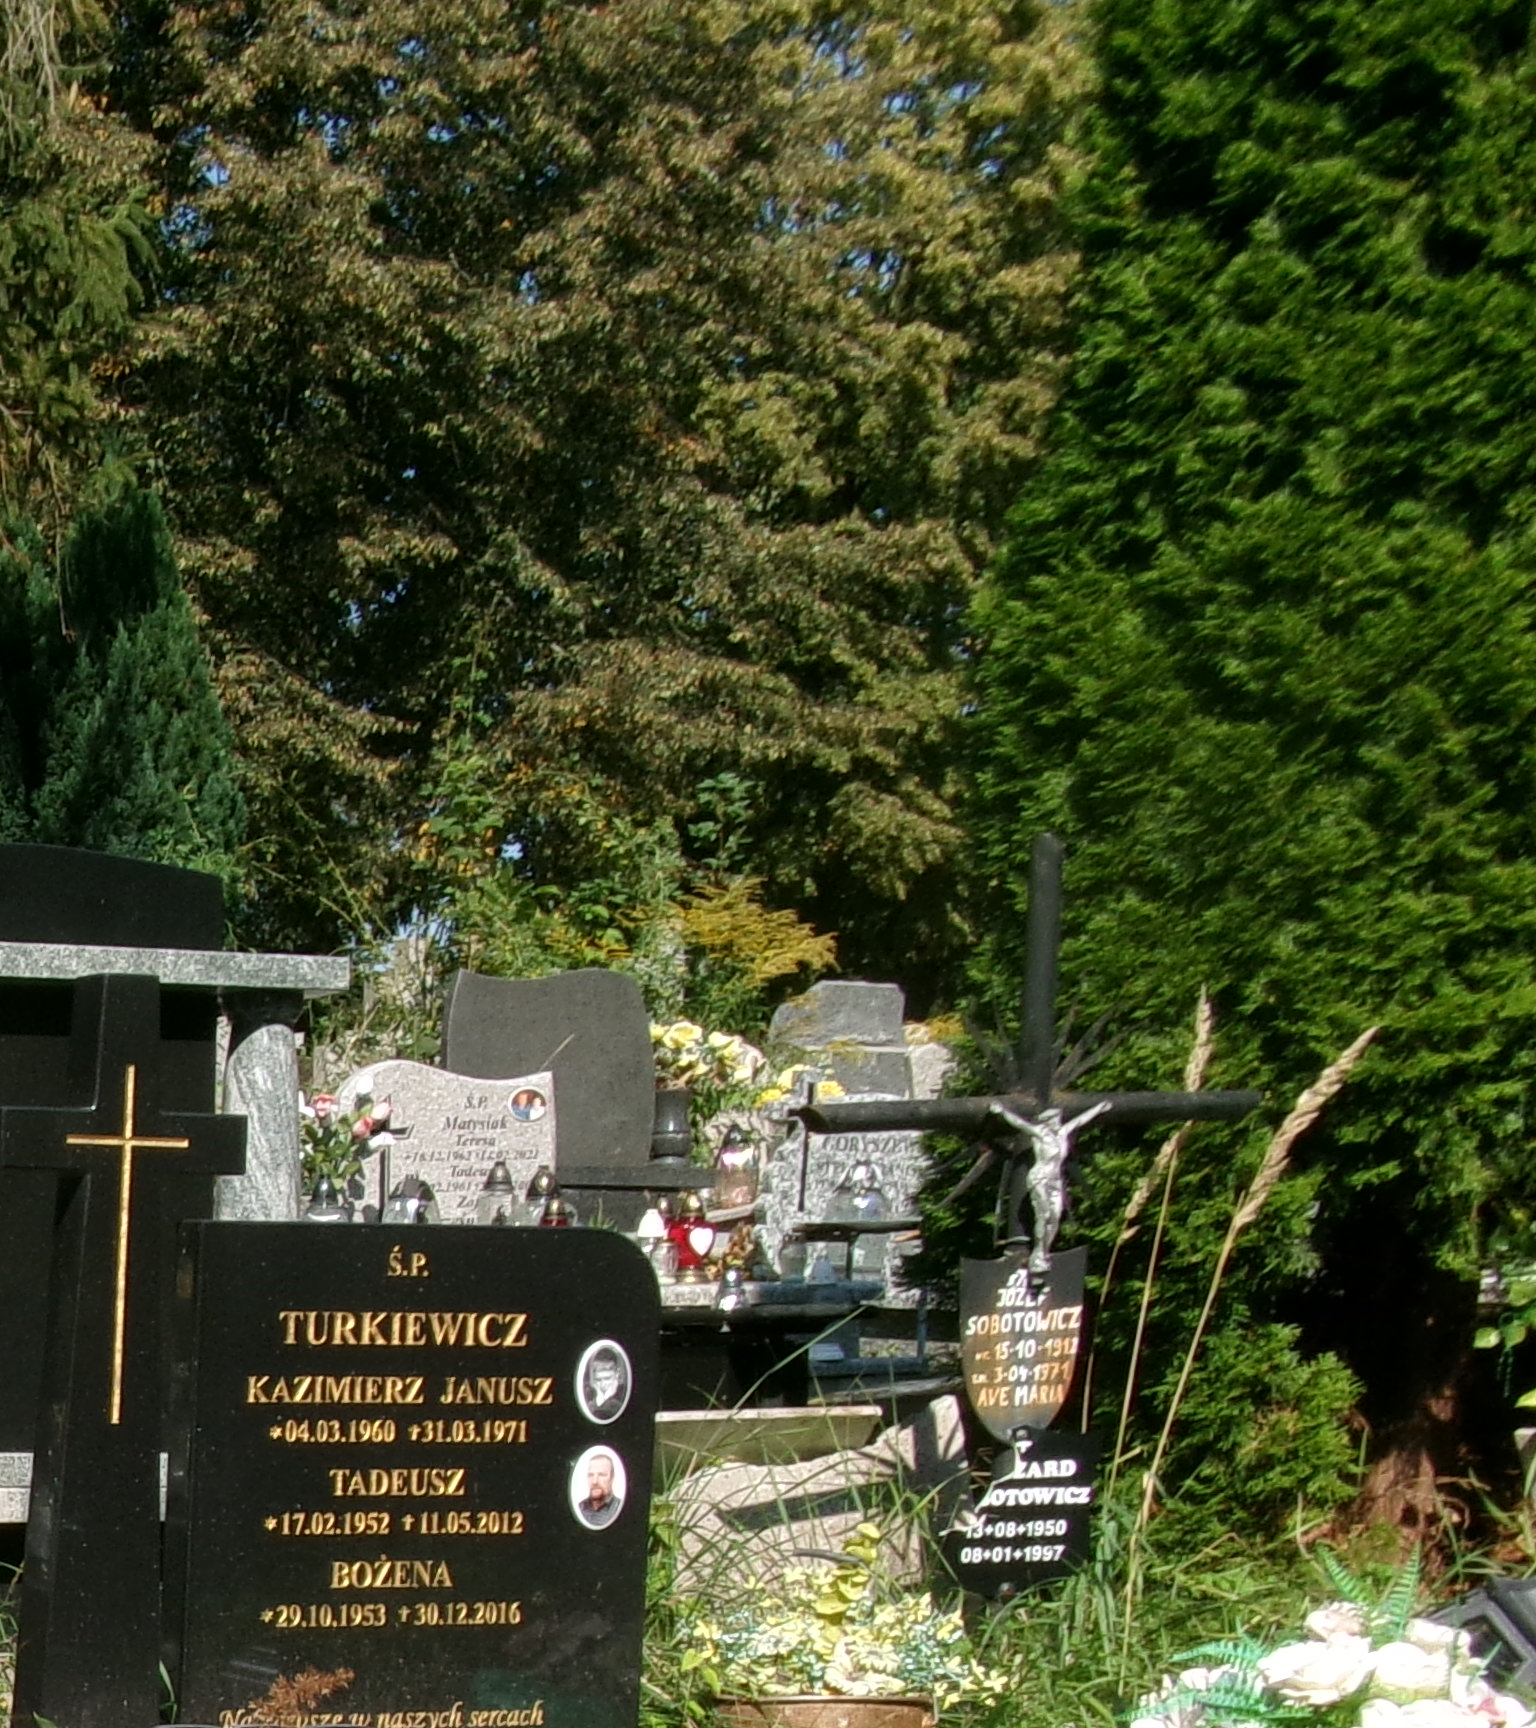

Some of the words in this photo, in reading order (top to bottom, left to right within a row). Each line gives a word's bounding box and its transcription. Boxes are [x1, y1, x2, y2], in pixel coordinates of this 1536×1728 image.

[456, 1134, 496, 1146] Teresa
[387, 1246, 430, 1277] Ś.P.
[278, 1311, 528, 1348] TURKIEWICZ
[965, 1304, 1083, 1336] SOBOTOWICZ
[246, 1375, 425, 1405] KAZIMIERZ
[440, 1376, 554, 1405] JANUSZ
[977, 1386, 1011, 1407] AVE
[329, 1469, 466, 1497] TADEUSZ
[330, 1554, 453, 1590] BOŻENA
[467, 1699, 545, 1728] sercach
